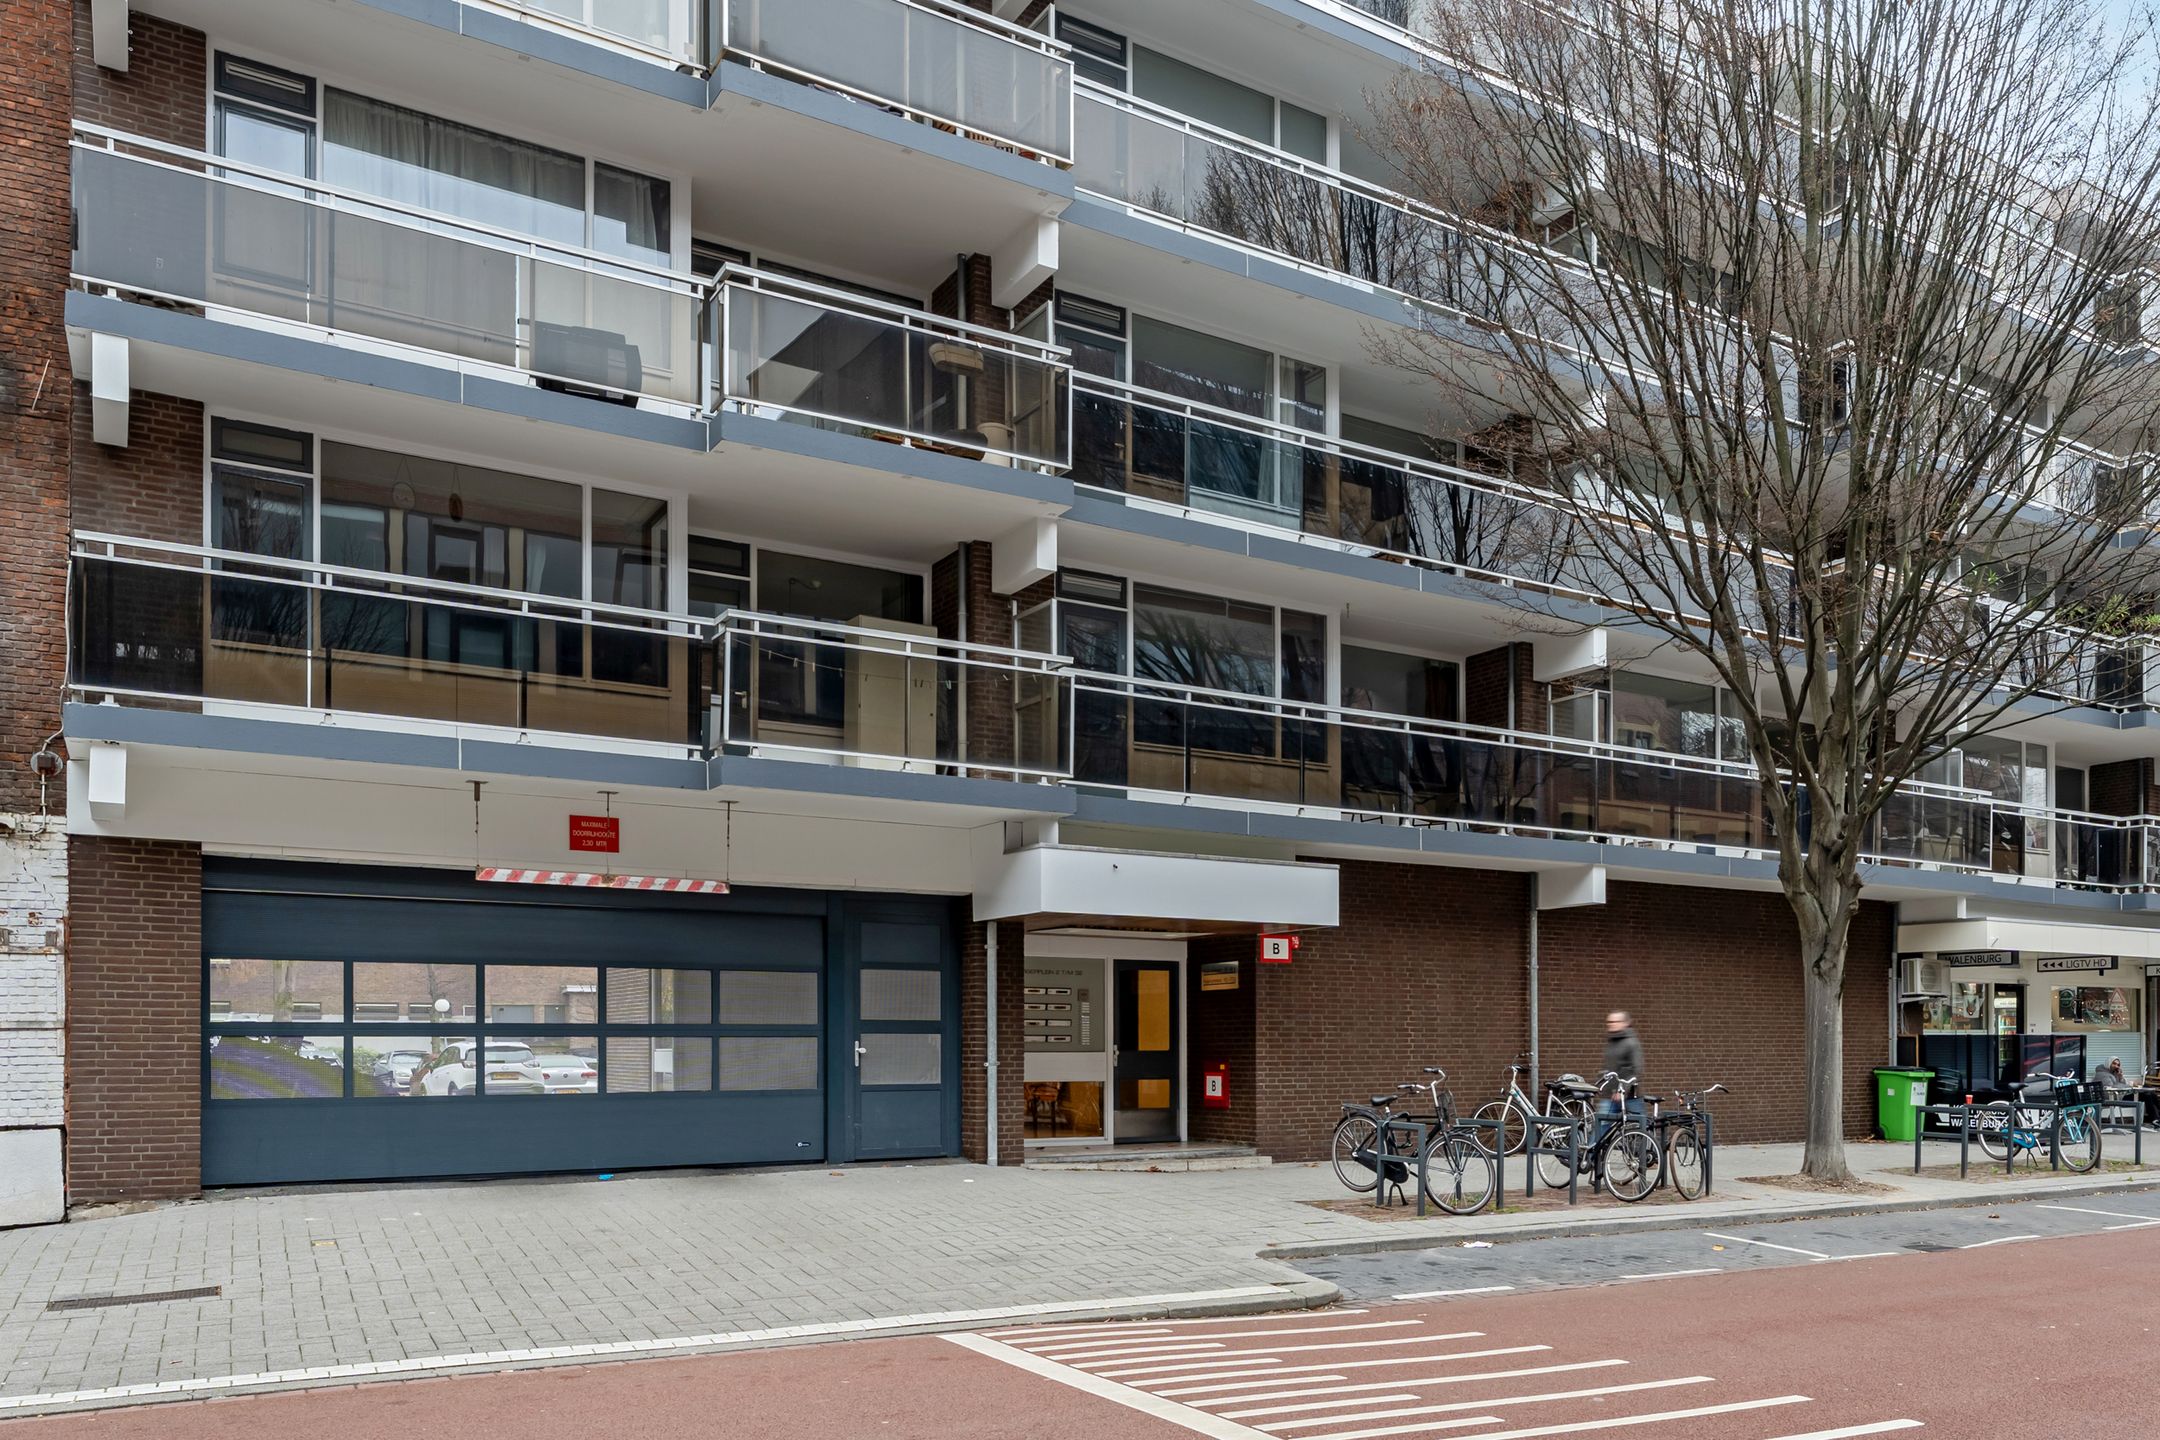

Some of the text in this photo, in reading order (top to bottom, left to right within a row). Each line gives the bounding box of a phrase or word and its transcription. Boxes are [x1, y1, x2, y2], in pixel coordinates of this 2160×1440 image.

[1272, 943, 1280, 955] B
[1945, 953, 2002, 965] WALENBURG
[2066, 959, 2107, 969] LIGTV HD
[1211, 1080, 1217, 1091] B
